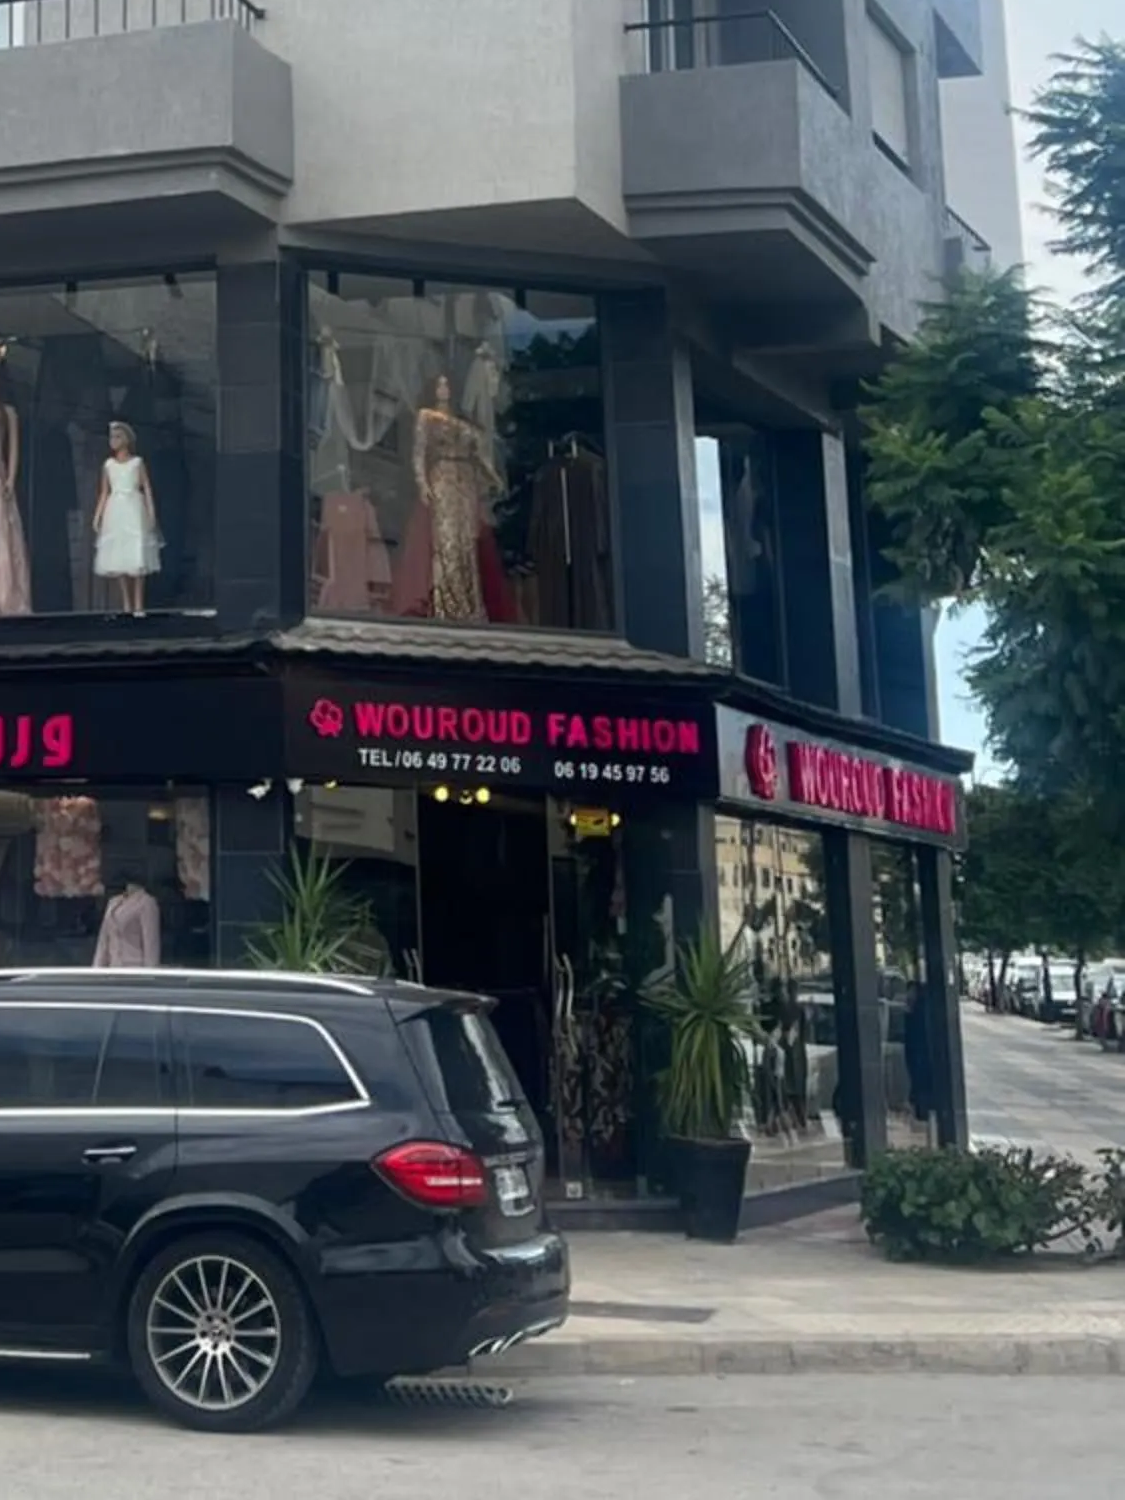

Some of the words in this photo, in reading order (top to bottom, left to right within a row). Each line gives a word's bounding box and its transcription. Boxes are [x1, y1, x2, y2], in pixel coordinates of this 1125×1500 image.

[352, 701, 532, 745] WOUROUD
[546, 712, 701, 754] FASHION
[427, 752, 448, 770] 49
[452, 754, 472, 771] 77
[475, 755, 497, 772] 22
[500, 756, 521, 774] 06
[554, 760, 574, 779] 06
[579, 762, 598, 780] 19
[602, 763, 622, 781] 45
[626, 764, 645, 782] 97
[650, 765, 670, 784] 56
